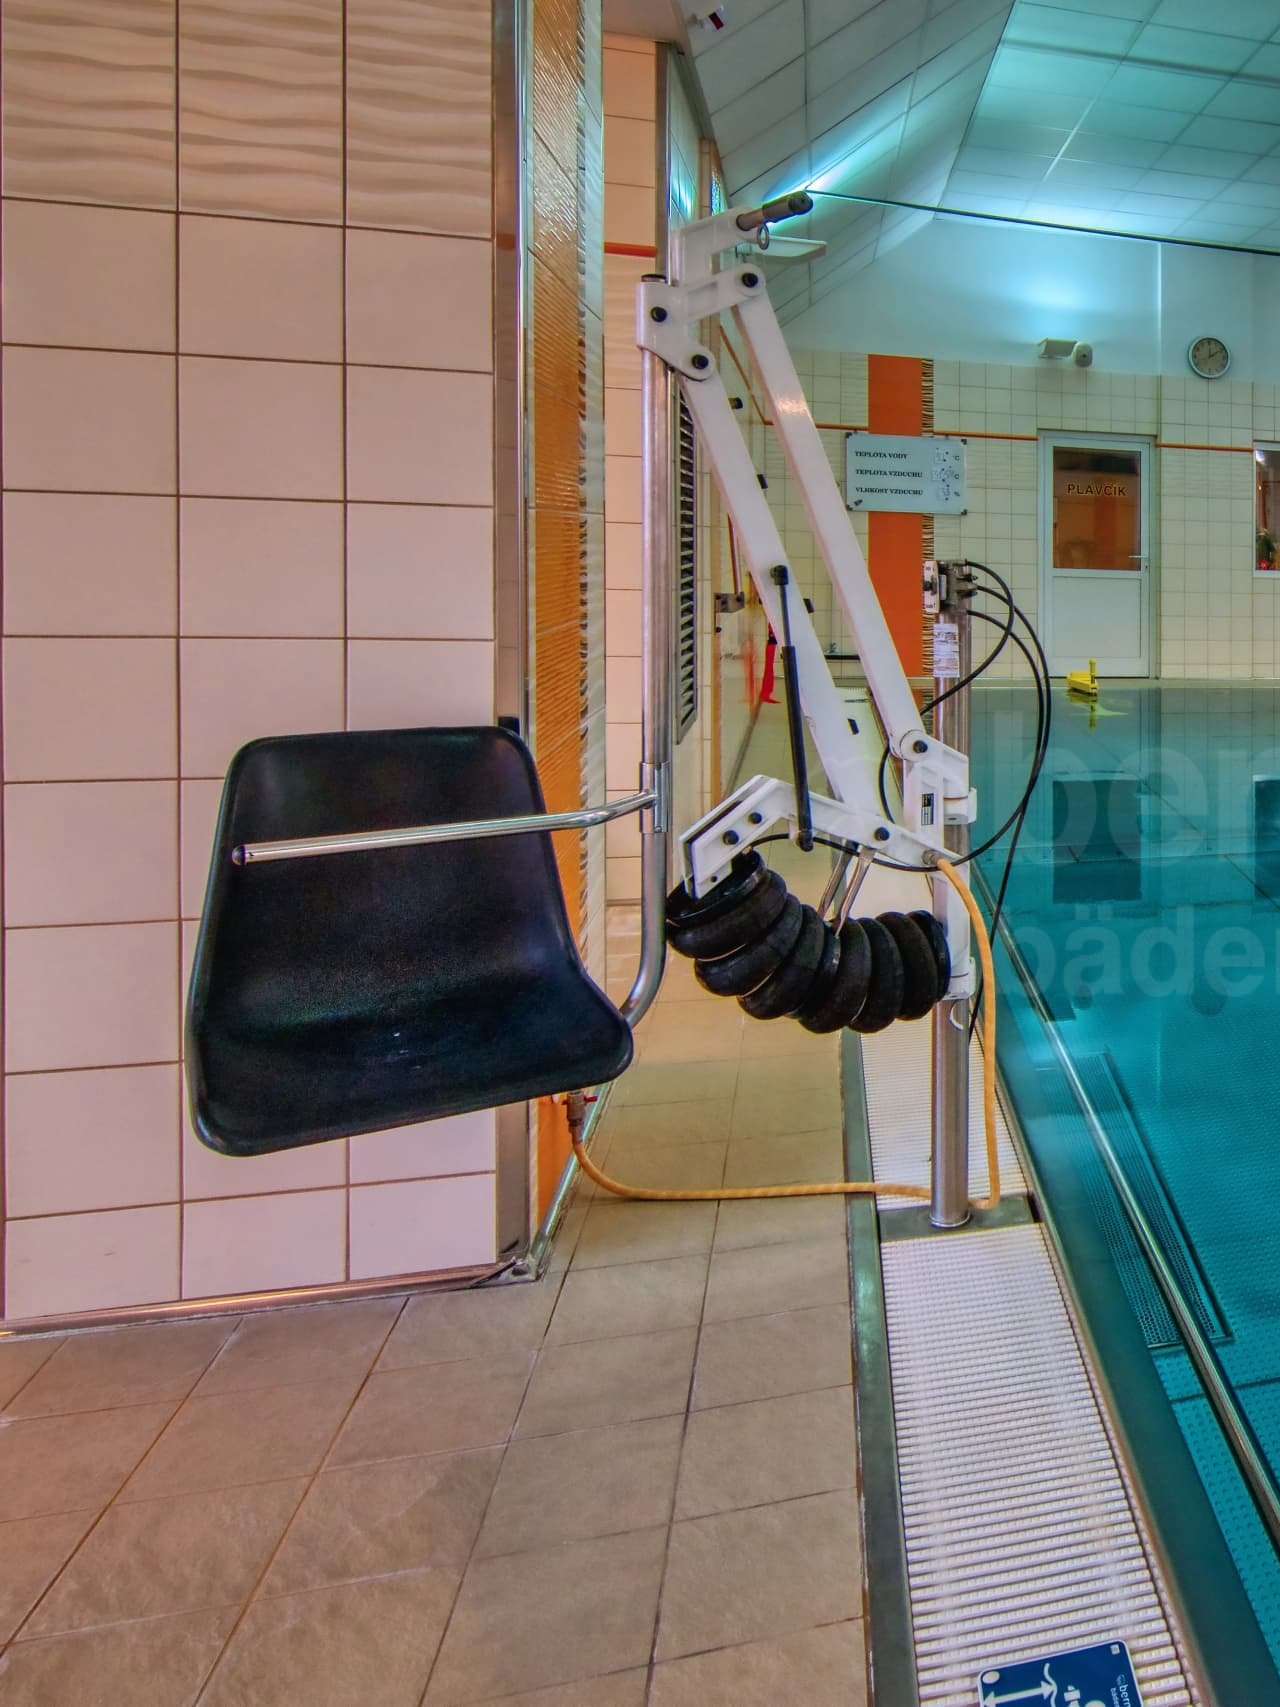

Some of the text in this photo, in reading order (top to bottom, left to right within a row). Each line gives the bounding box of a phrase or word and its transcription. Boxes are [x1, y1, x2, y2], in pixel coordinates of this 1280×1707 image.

[855, 451, 887, 459] TEPLOTA
[855, 469, 888, 477] TEPLOTA
[888, 470, 923, 478] VZDUCHU
[855, 487, 888, 495] VLHKOST
[889, 488, 924, 496] VZDUCHU
